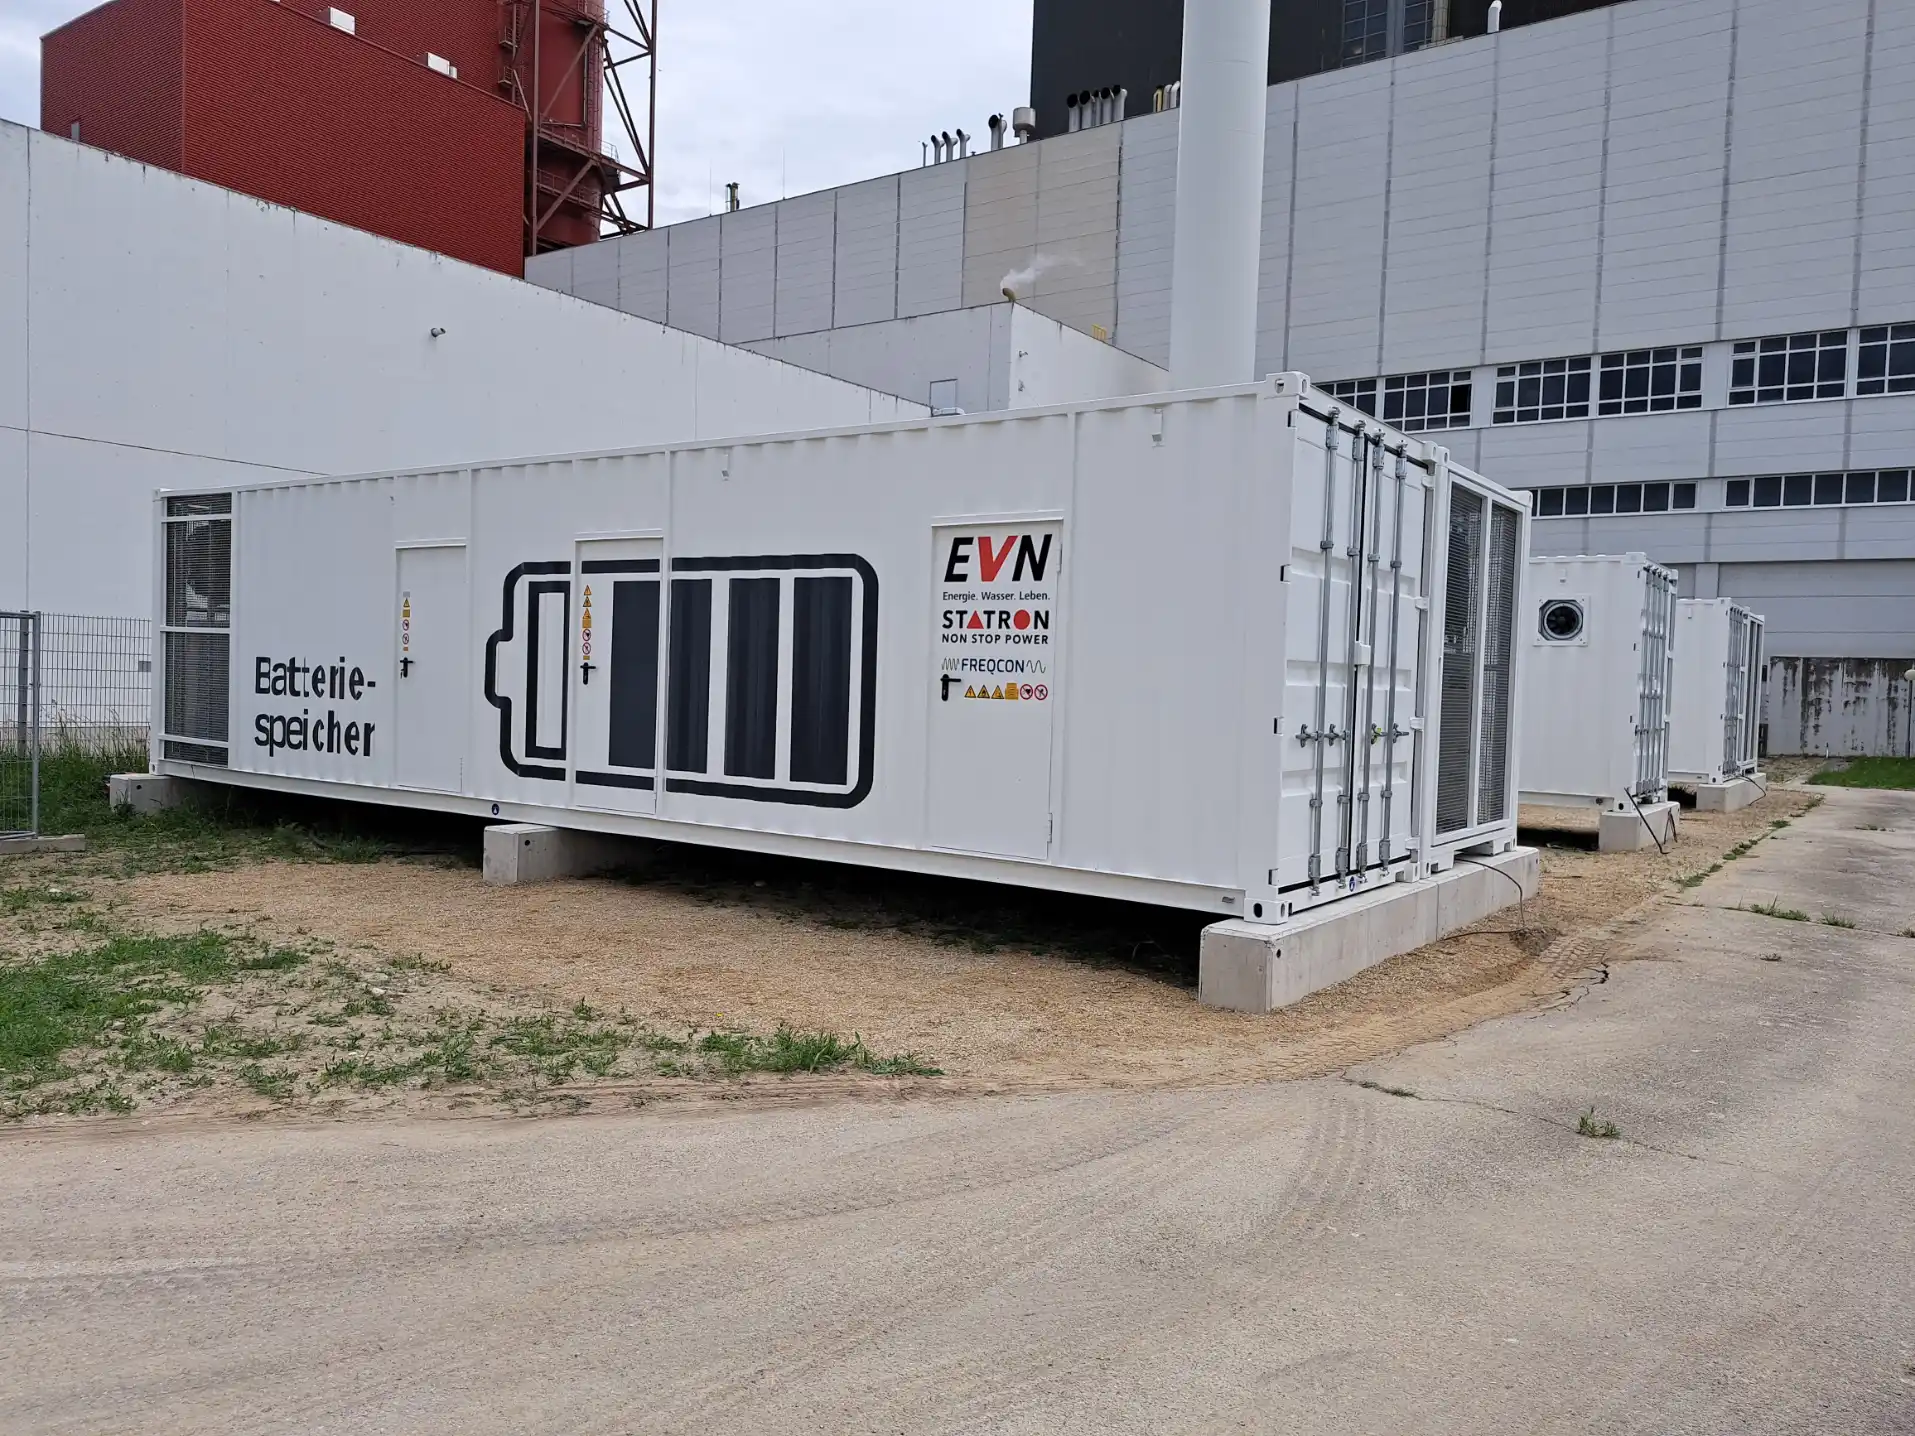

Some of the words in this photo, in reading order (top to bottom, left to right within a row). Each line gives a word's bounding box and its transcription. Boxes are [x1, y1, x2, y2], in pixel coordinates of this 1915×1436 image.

[944, 534, 1053, 582] EVN
[942, 591, 978, 603] Energie.
[981, 591, 1016, 601] Wasser.
[1019, 590, 1051, 601] Leben.
[942, 609, 1049, 630] STATRON
[942, 633, 967, 643] NON
[971, 634, 1001, 644] STOP
[1005, 634, 1049, 645] POWER
[961, 658, 1025, 674] FREQCON
[255, 656, 376, 701] Batterie-
[254, 708, 376, 757] speicher
